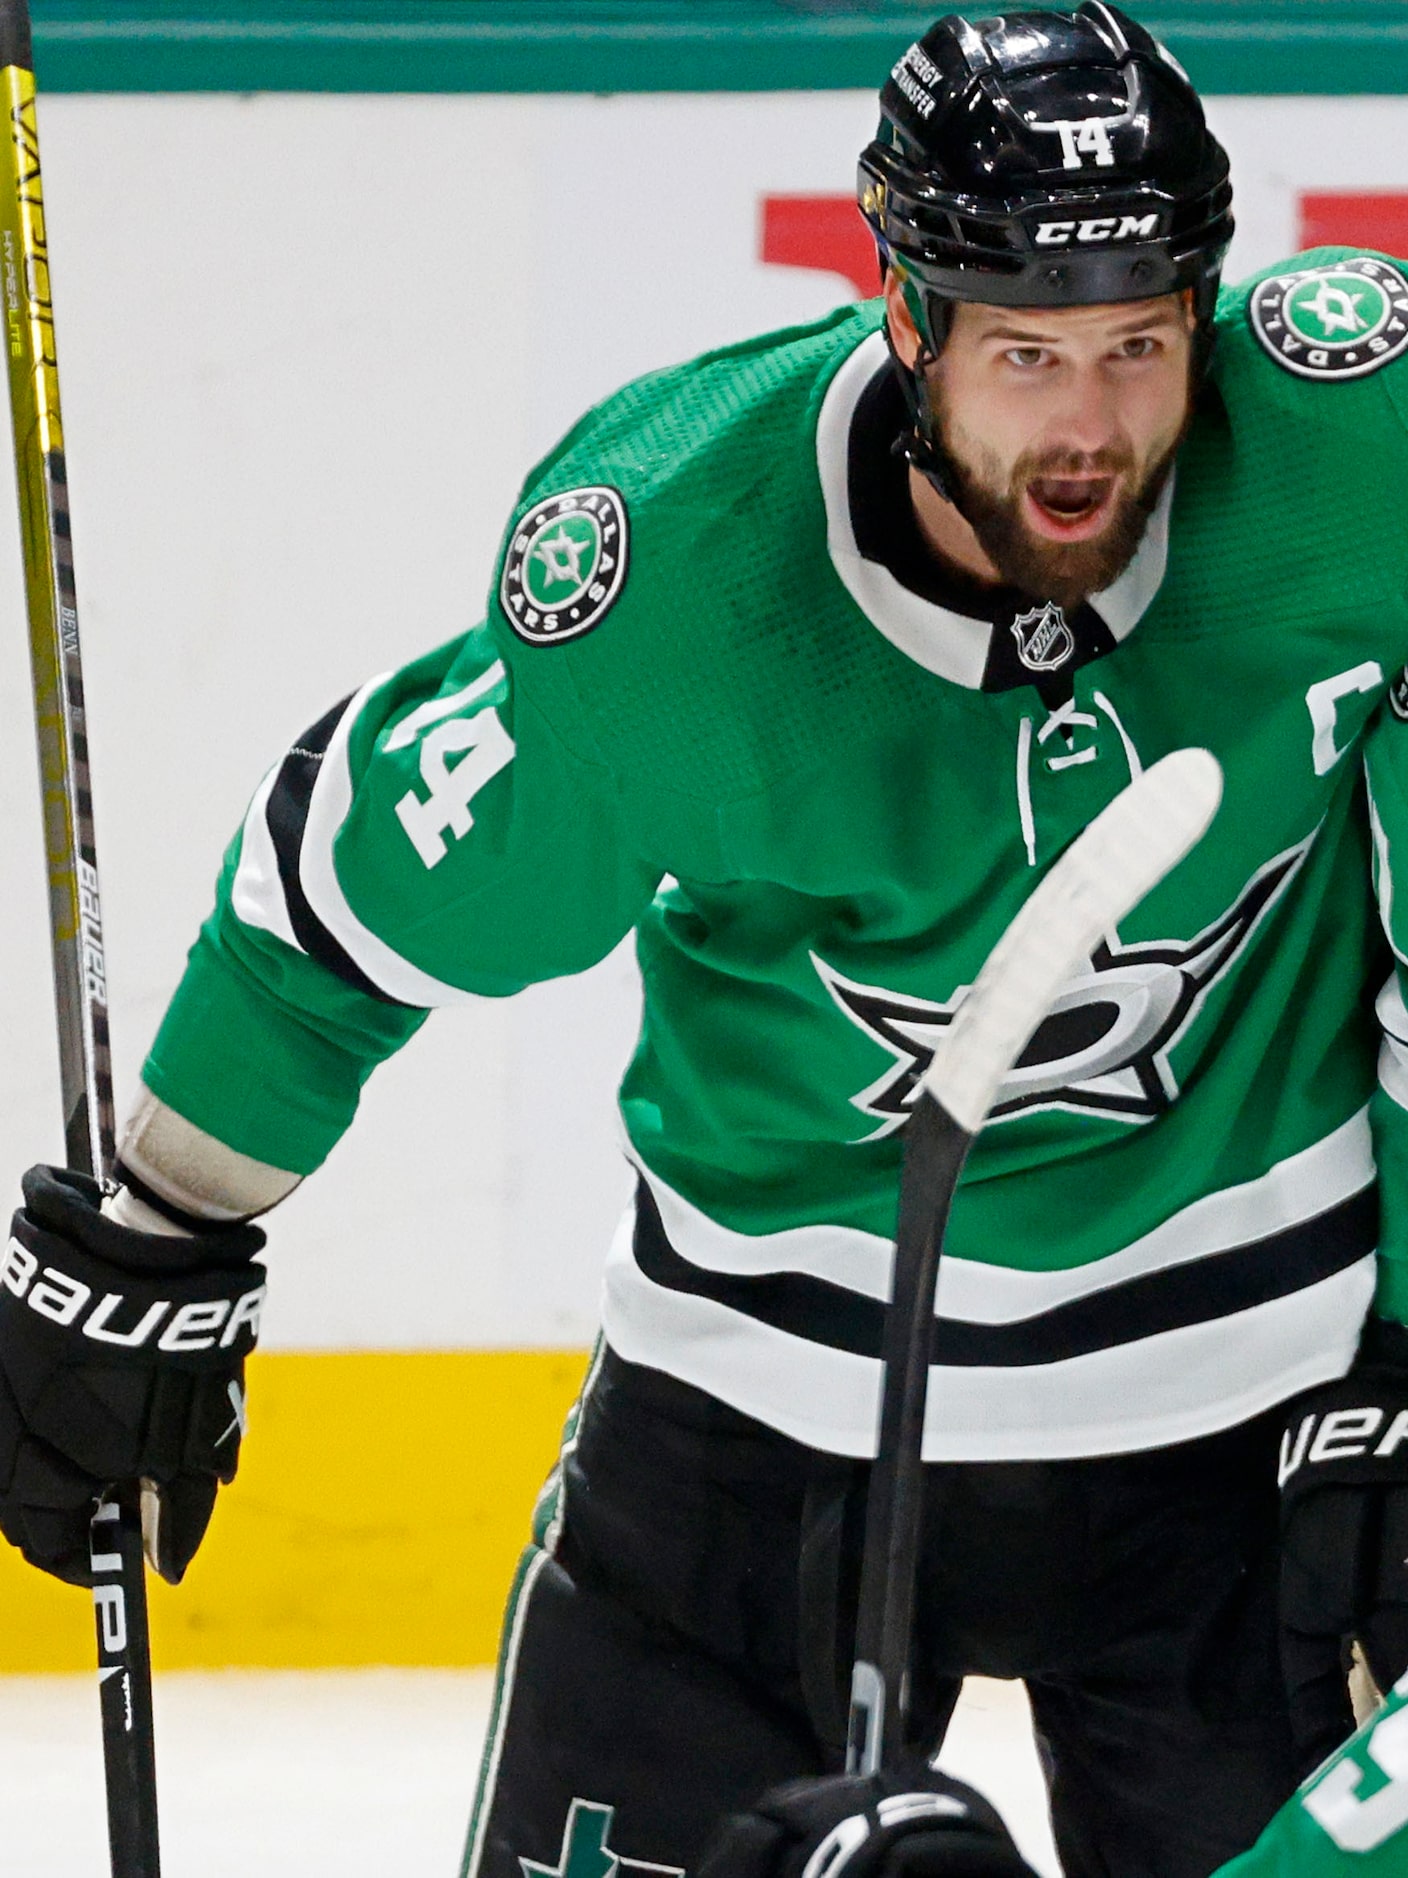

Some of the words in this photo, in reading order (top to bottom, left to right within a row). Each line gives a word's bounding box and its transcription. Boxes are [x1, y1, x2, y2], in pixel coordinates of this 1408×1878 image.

[1054, 116, 1115, 169] 14
[1035, 213, 1159, 244] CCM
[508, 533, 559, 632] STARS
[557, 494, 617, 603] DALLAS
[62, 605, 79, 655] BENN
[382, 657, 517, 871] 14
[1305, 660, 1384, 777] C
